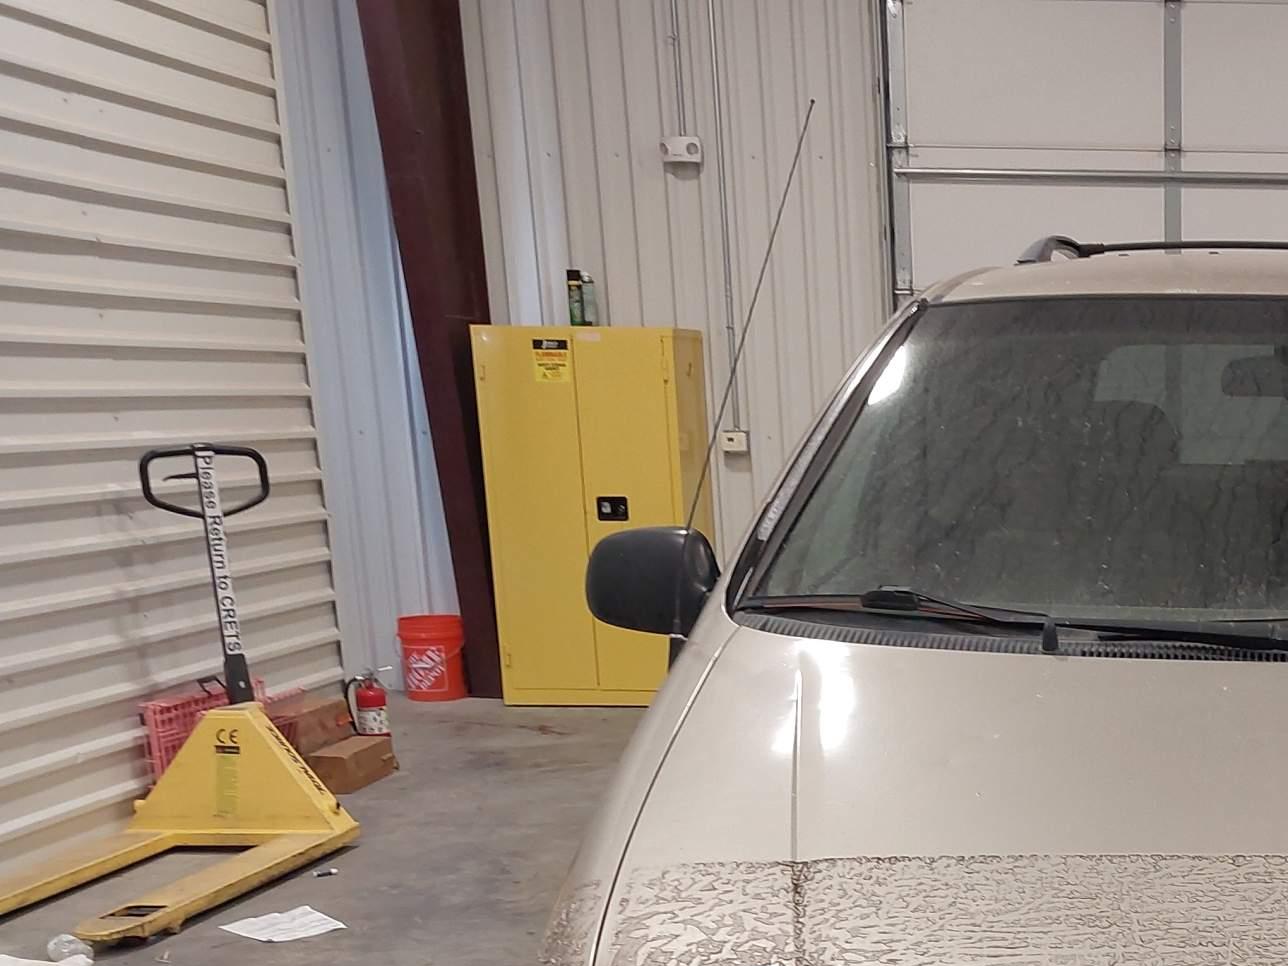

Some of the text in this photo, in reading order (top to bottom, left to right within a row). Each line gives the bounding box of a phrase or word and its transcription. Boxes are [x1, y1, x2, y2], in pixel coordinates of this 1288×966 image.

[199, 455, 217, 509] Please
[207, 515, 226, 570] Return
[217, 574, 231, 591] to
